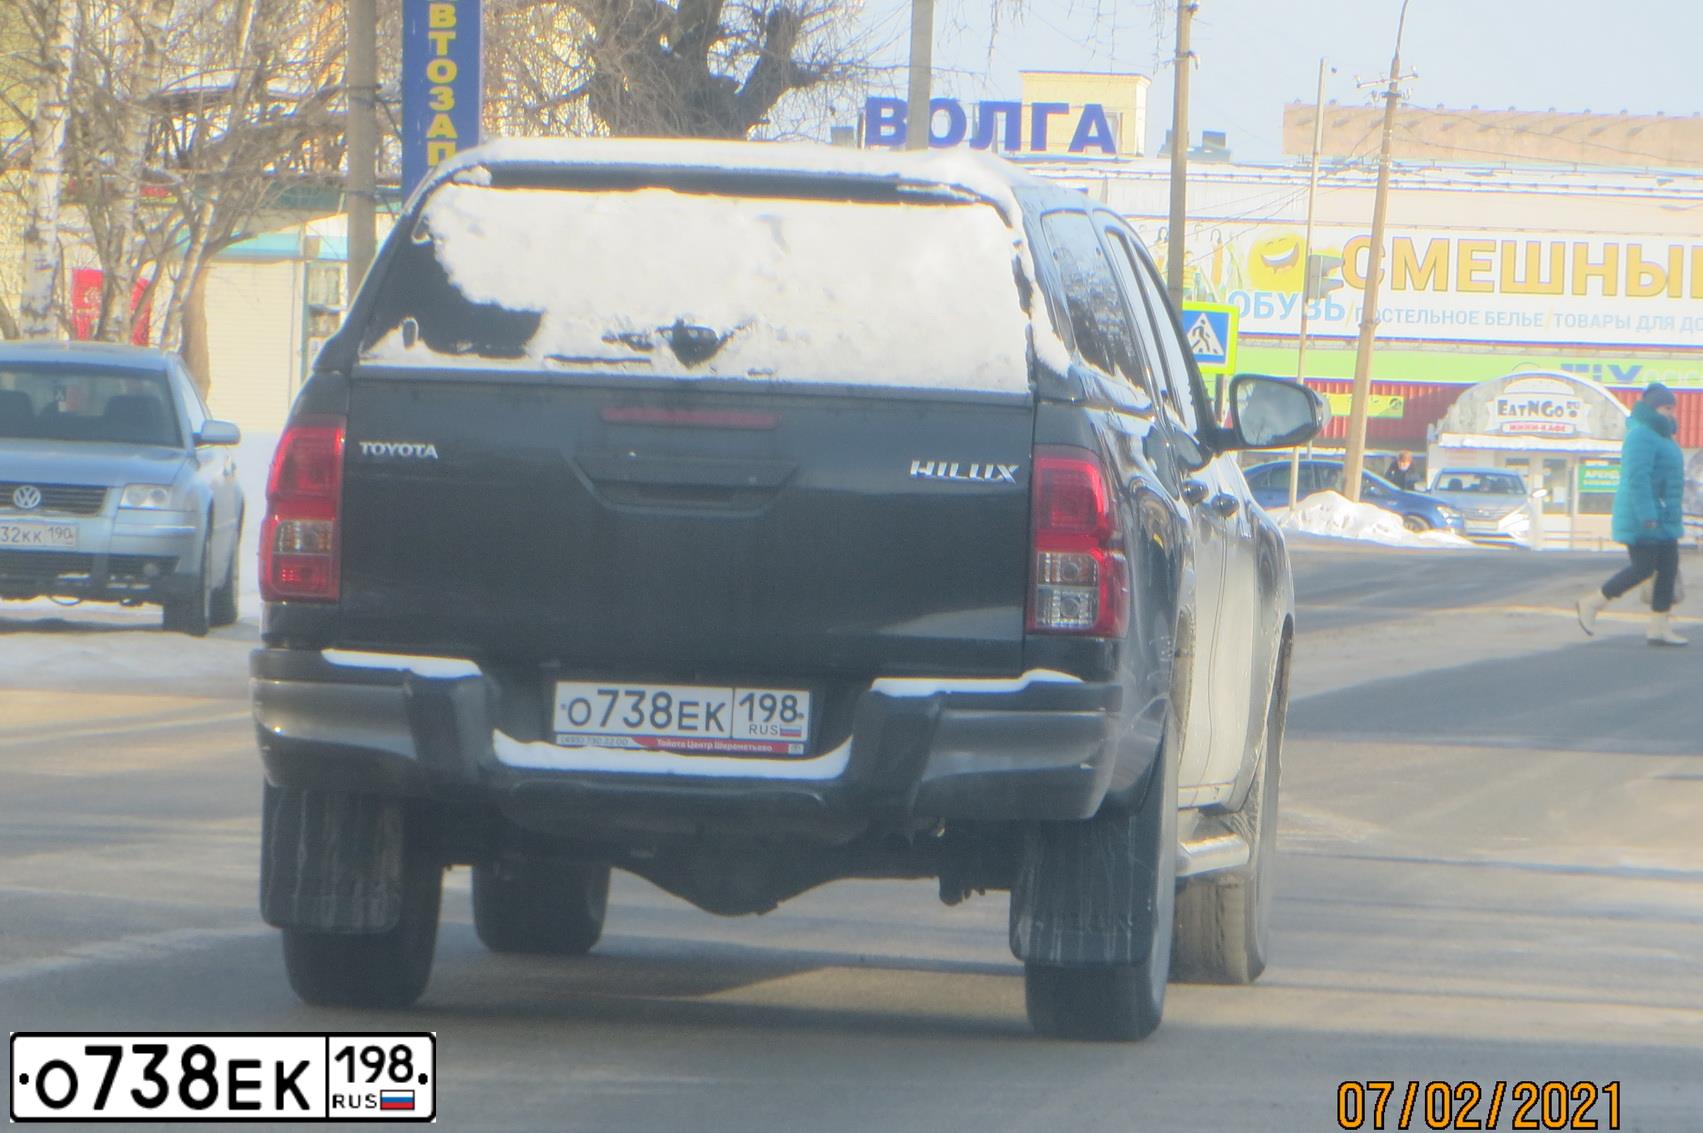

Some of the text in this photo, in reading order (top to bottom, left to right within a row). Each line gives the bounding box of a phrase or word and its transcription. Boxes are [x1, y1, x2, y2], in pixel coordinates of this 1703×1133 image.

[426, 0, 458, 166] ВТОЗАП
[865, 96, 1117, 154] ВОЛГА
[1485, 310, 1544, 328] БЕЛЬЕ
[1553, 312, 1630, 330] ТОВАРЫ
[1636, 315, 1675, 333] ДЛЯ
[359, 441, 438, 459] TOYOTA
[910, 460, 1019, 484] HILUX
[567, 689, 798, 732] О738ЕК 198
[749, 723, 778, 735] RUS
[656, 739, 686, 748] Тойота
[687, 740, 713, 750] Центр
